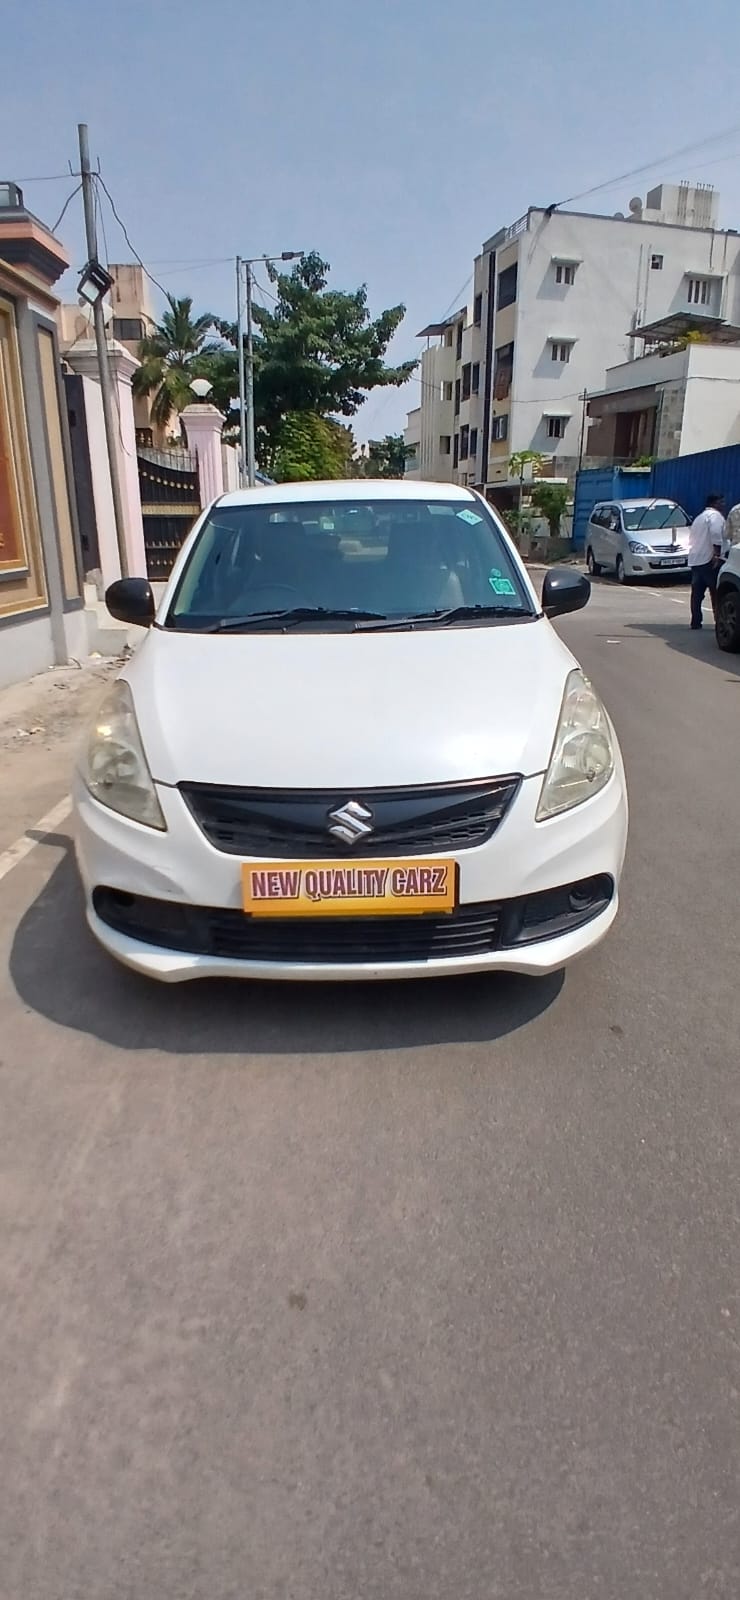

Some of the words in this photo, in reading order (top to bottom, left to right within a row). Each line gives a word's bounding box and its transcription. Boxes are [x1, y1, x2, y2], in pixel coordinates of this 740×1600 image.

[251, 870, 301, 899] NEW
[304, 868, 388, 901] QUALITY
[391, 867, 446, 896] CARZ
